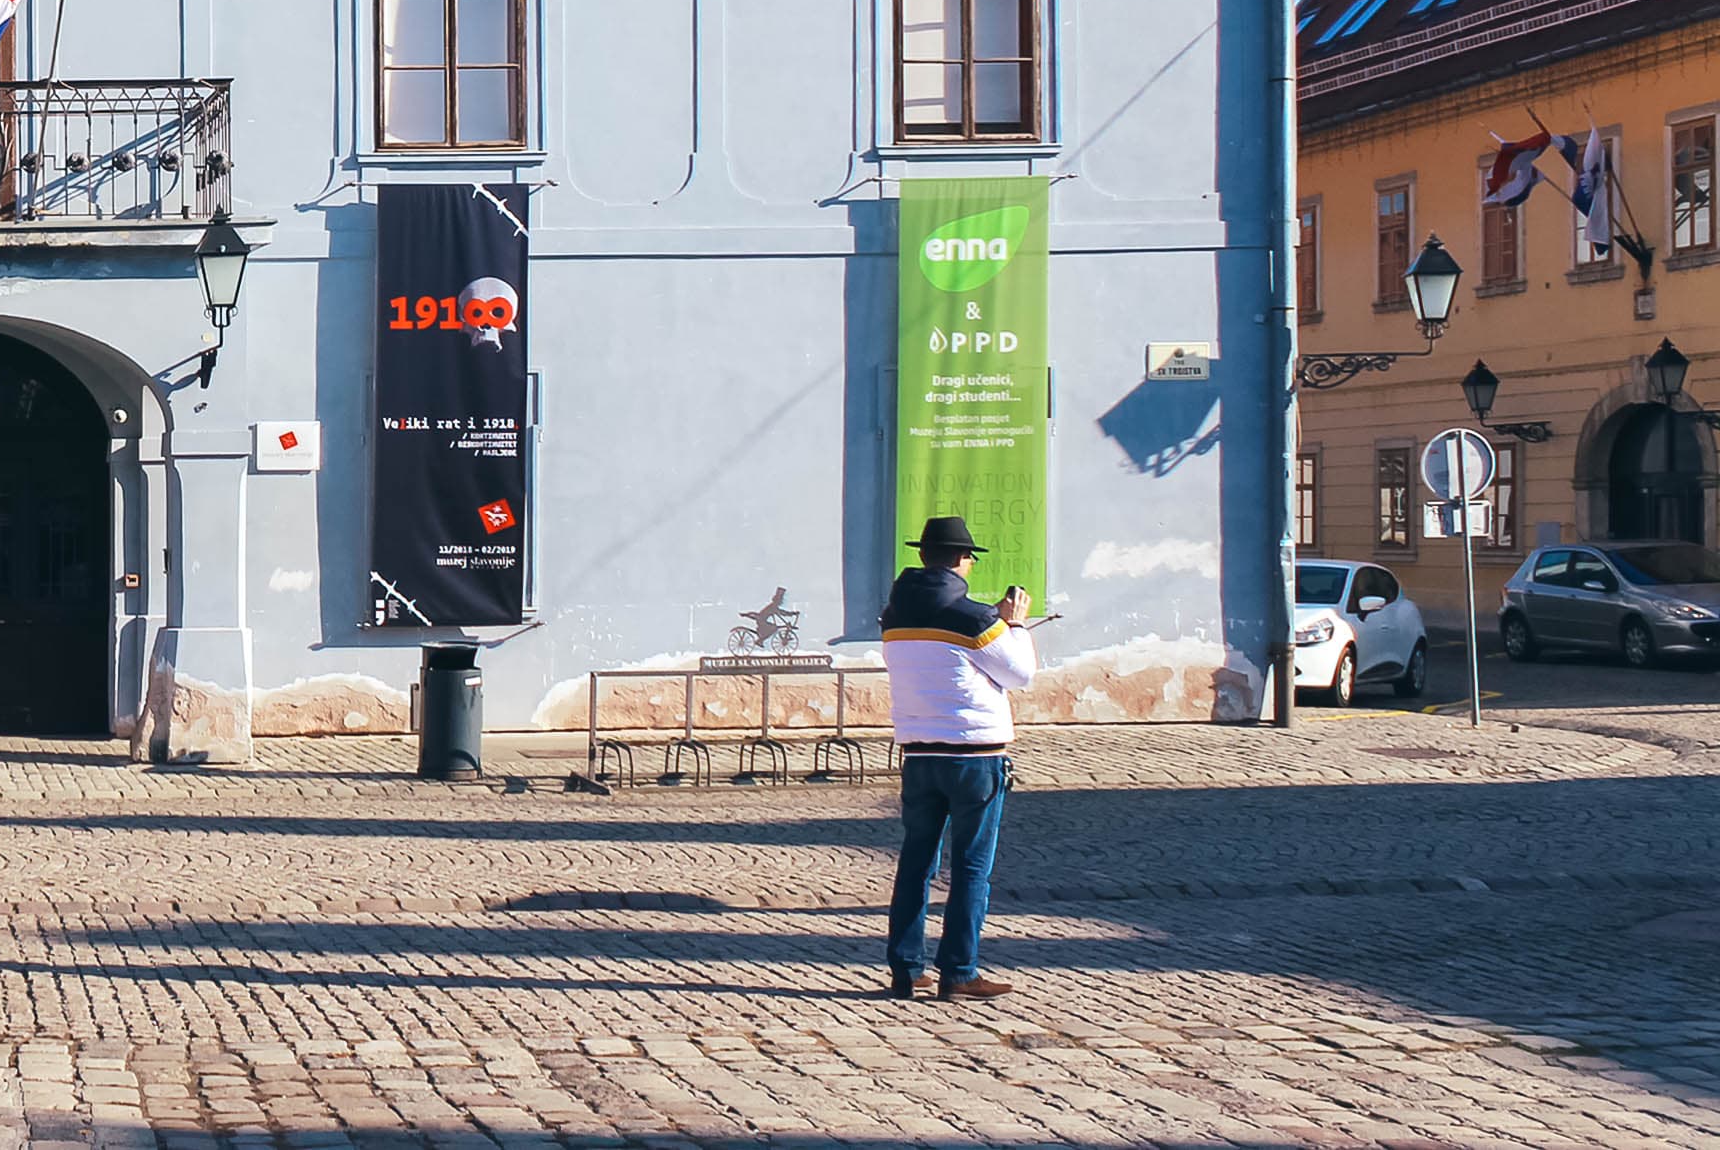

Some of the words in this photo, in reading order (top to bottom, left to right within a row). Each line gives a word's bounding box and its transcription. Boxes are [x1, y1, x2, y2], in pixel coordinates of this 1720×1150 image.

[925, 238, 1008, 262] enna
[966, 301, 982, 320] &
[932, 375, 965, 388] Dragi
[967, 373, 1014, 387] učenici,
[925, 391, 957, 404] dragi
[383, 417, 429, 429] Veliki
[437, 418, 460, 429] rat
[467, 417, 476, 429] i
[483, 418, 519, 429] 1918.
[944, 426, 986, 437] Slavonije
[964, 439, 989, 448] ENNA
[901, 473, 1033, 493] INNOVATION
[935, 499, 1043, 525] ENERGY
[437, 557, 467, 569] muzej
[470, 556, 516, 568] slavonije
[704, 658, 735, 667] MUZEJ
